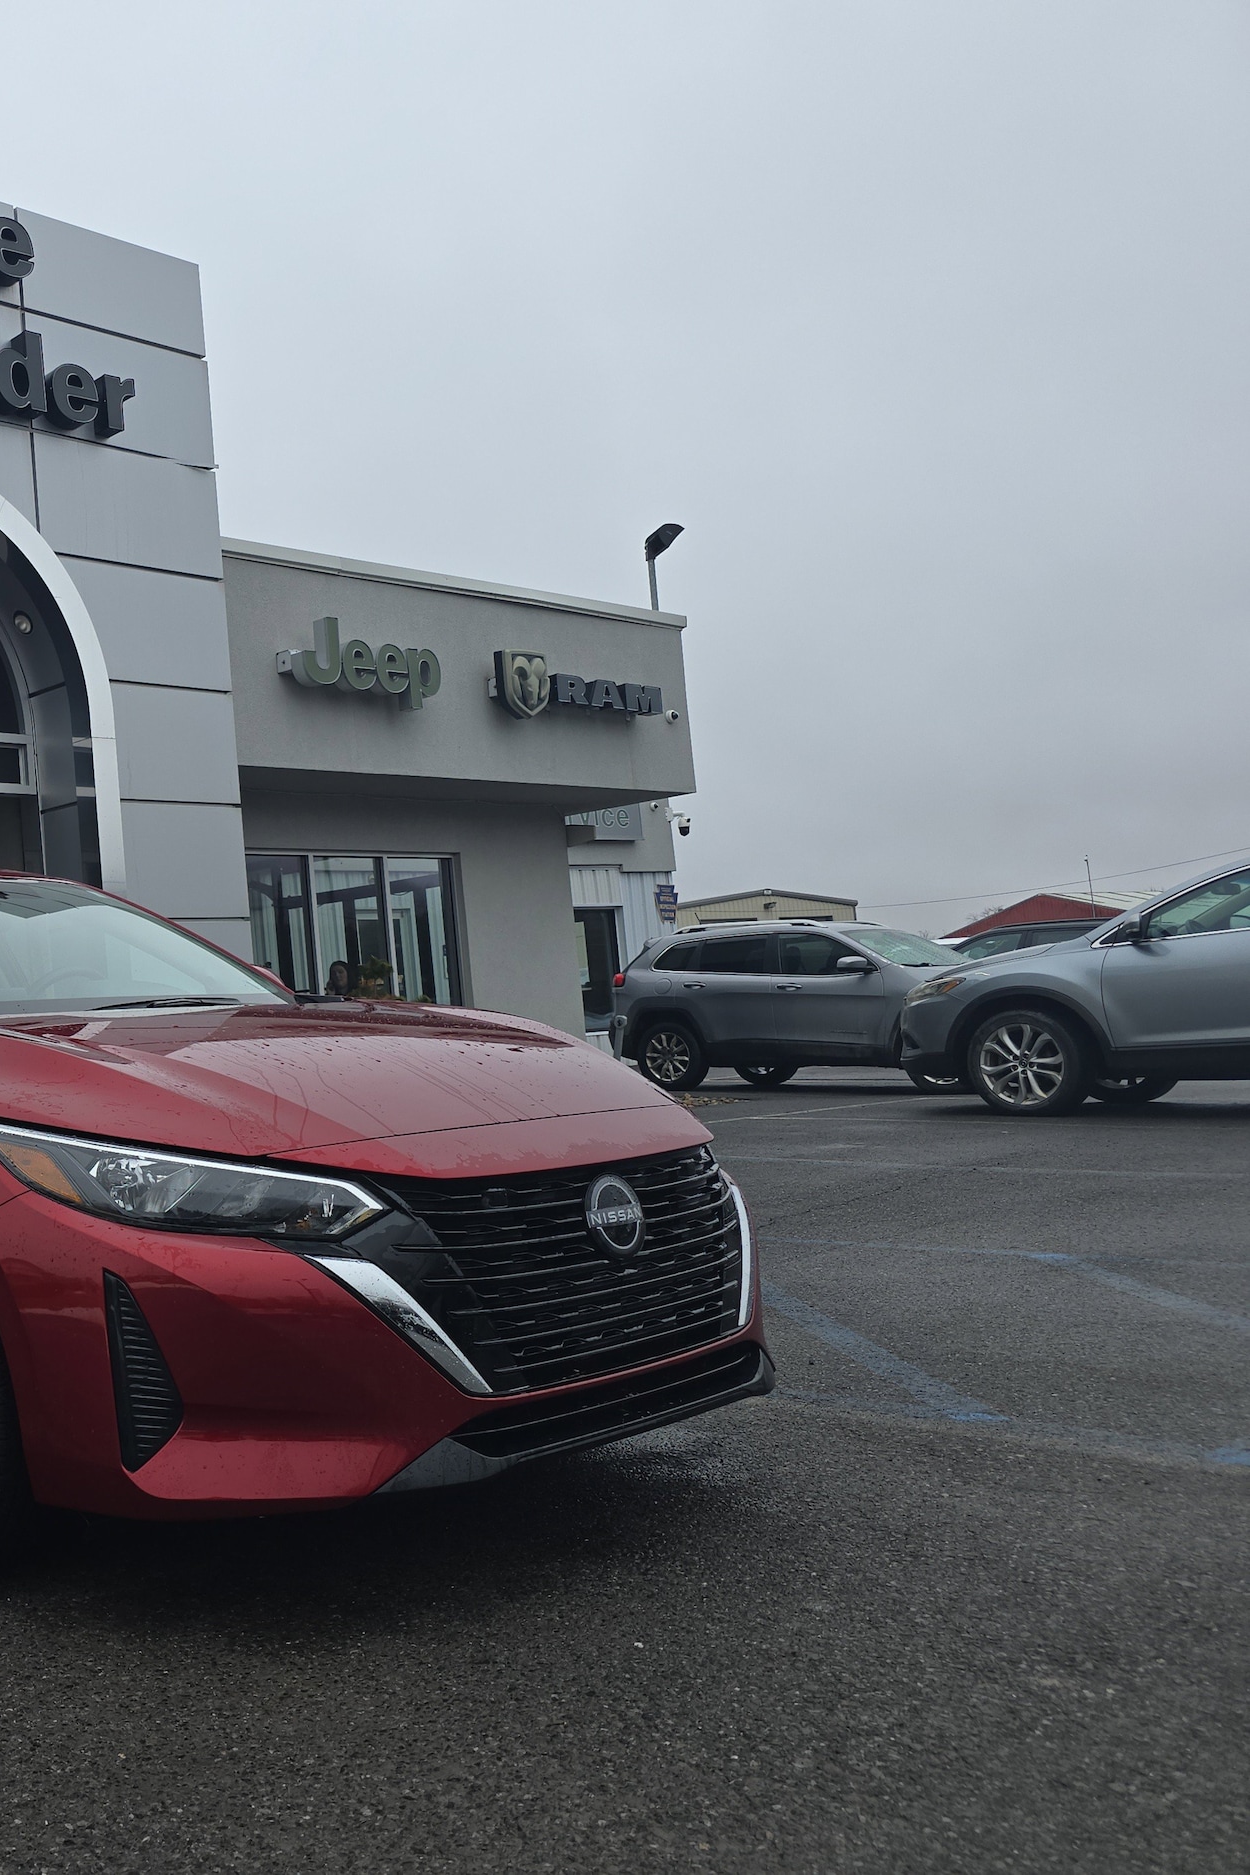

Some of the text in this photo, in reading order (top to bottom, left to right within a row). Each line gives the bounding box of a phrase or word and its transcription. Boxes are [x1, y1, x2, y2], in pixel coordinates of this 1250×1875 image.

[292, 616, 442, 711] Jeep
[550, 673, 663, 716] RAM
[590, 1206, 643, 1226] NISSAN
